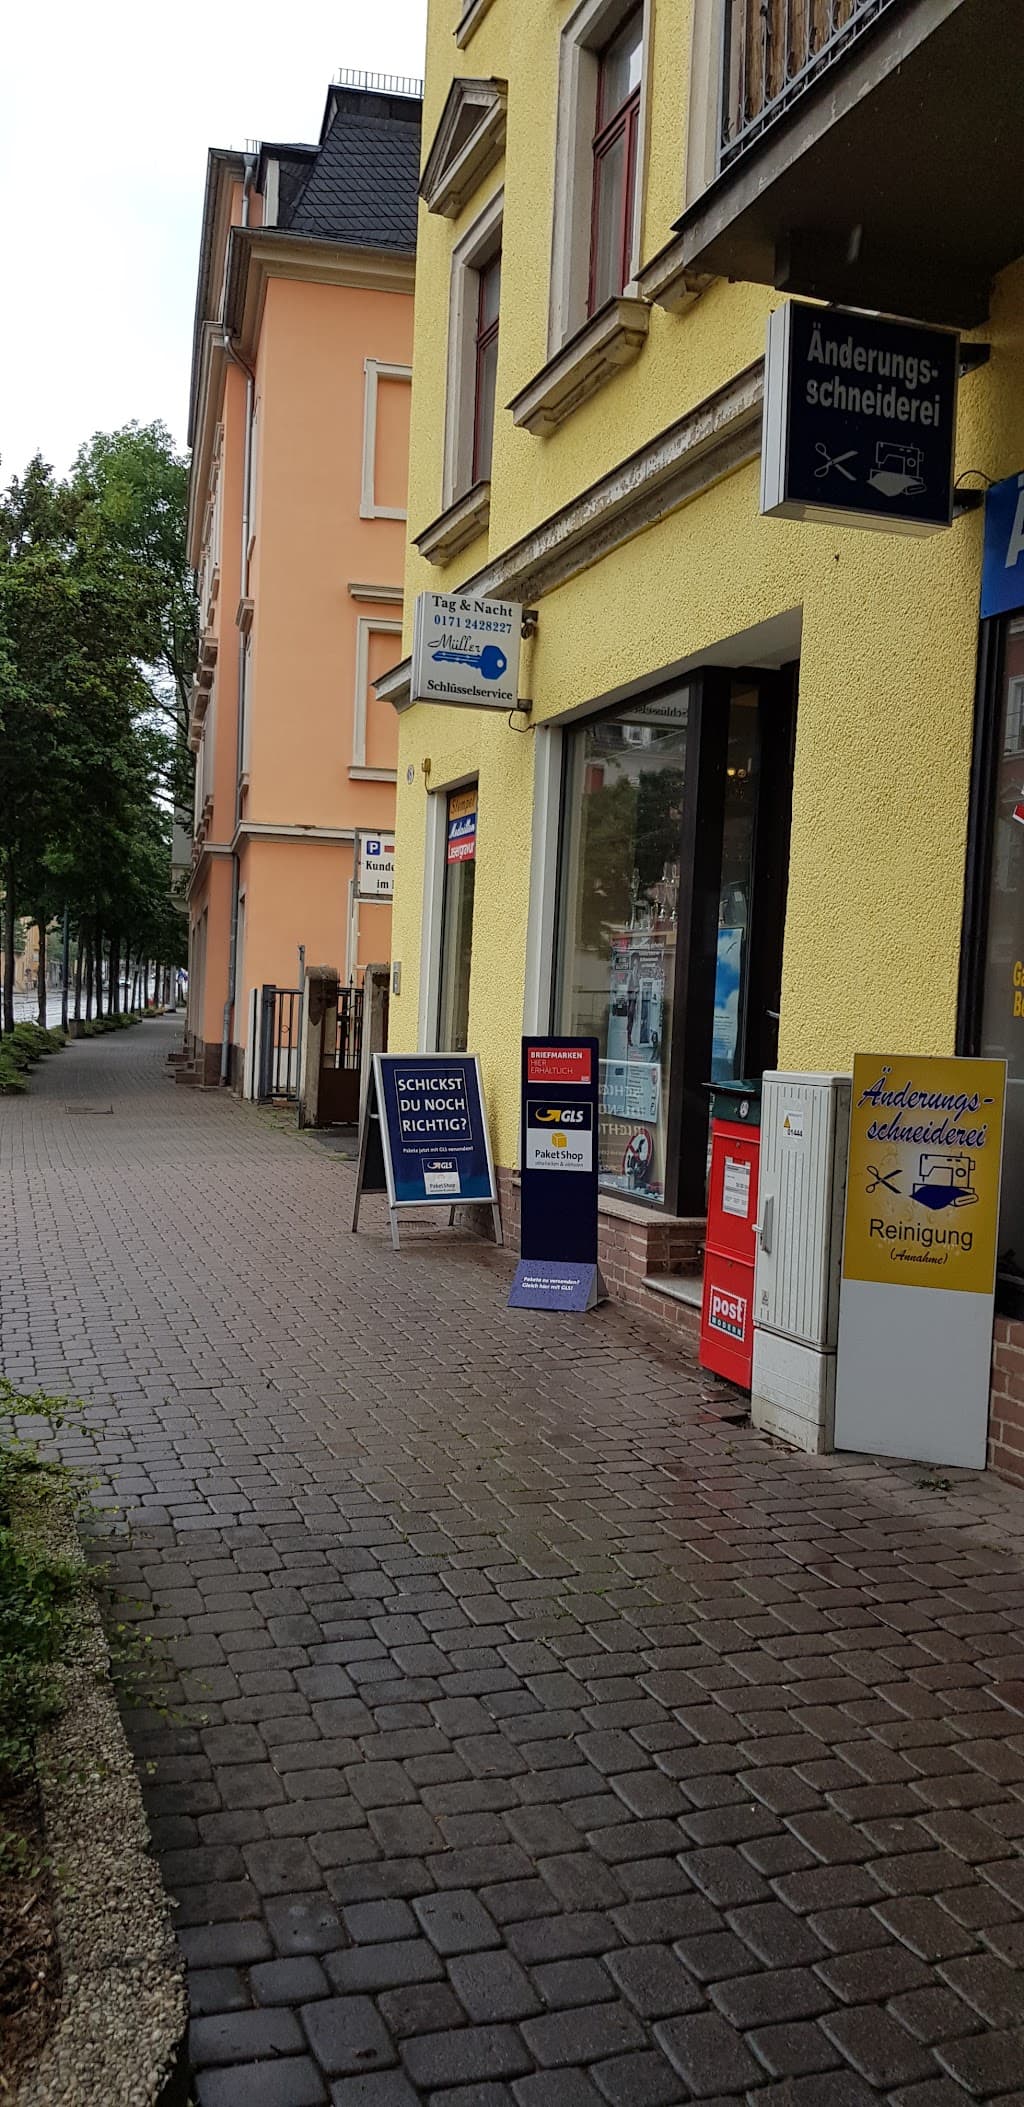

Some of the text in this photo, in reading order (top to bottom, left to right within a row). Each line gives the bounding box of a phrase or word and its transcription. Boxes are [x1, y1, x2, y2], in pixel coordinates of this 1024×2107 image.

[806, 321, 939, 390] Änderungs-
[805, 375, 940, 427] schneiderei
[432, 595, 513, 617] Tag & Nacht
[434, 614, 512, 633] 0171 2428227
[427, 633, 480, 653] Müller
[427, 680, 513, 700] Schlüsselservice
[377, 879, 389, 889] im
[530, 1051, 583, 1059] BRIEFMARKEN
[398, 1078, 463, 1092] SCHICKST
[857, 1066, 994, 1121] Änderungs-
[400, 1098, 465, 1112] DU NOCH
[403, 1118, 467, 1132] RICHTIG?
[561, 1109, 584, 1123] GLS
[867, 1112, 987, 1147] schneiderei
[440, 1161, 453, 1169] GLS
[869, 1218, 973, 1251] Reinigung
[890, 1247, 948, 1265] (Annahme)
[712, 1295, 743, 1323] post
[711, 1316, 742, 1337] MODERN
